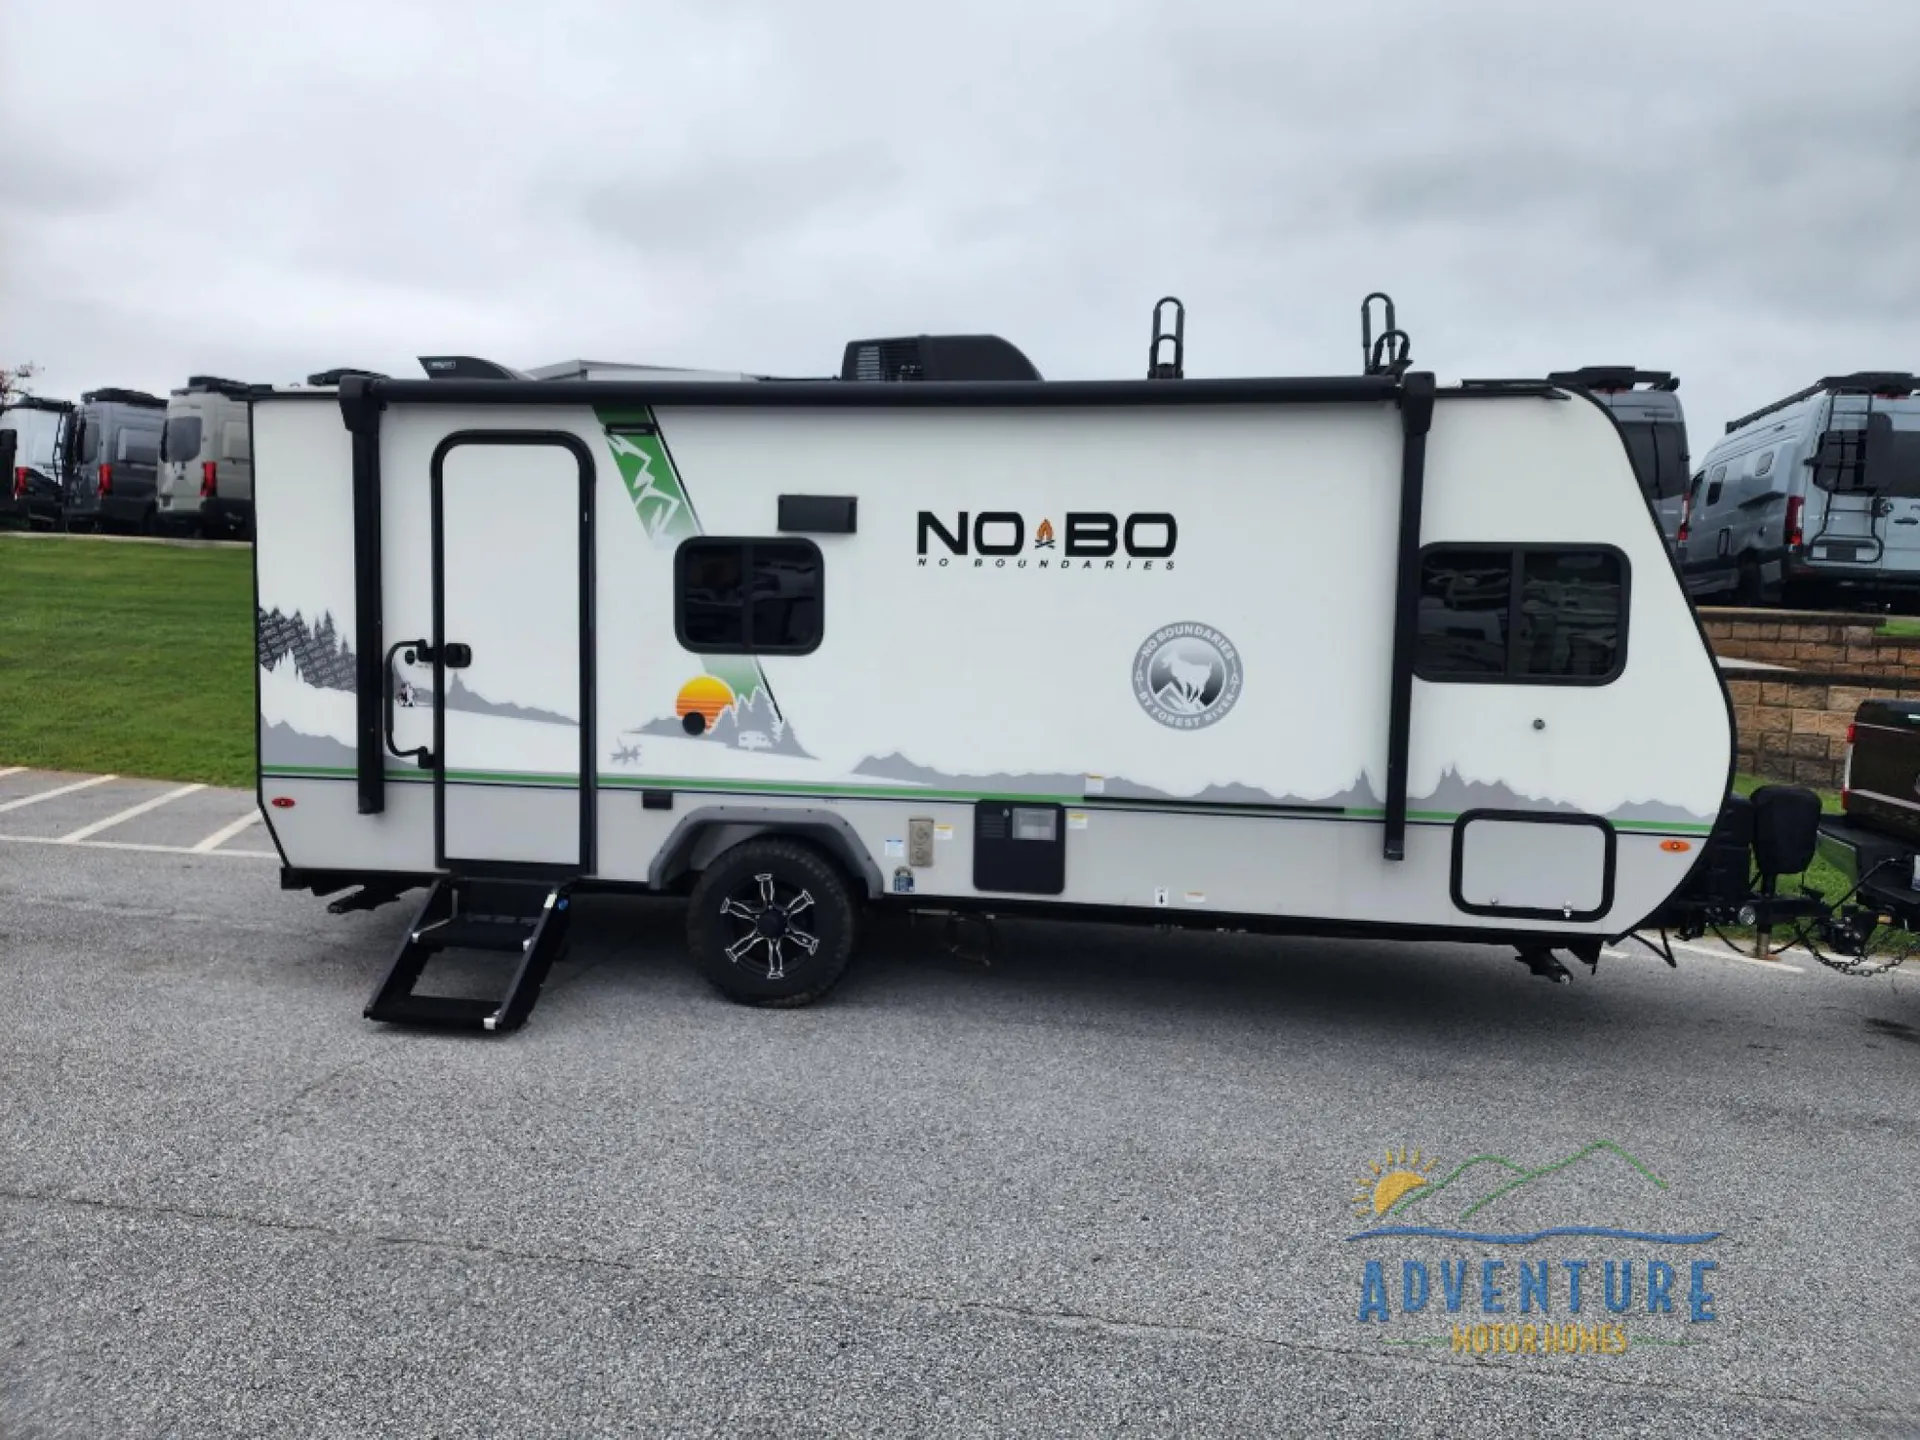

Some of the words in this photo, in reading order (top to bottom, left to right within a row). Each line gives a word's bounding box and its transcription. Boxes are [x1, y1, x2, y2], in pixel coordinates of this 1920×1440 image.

[917, 511, 1025, 556] NO
[1064, 512, 1178, 558] BO
[917, 558, 950, 568] NO
[974, 558, 1175, 571] BOUNDARIES
[1156, 624, 1235, 660] BOUNDARIES
